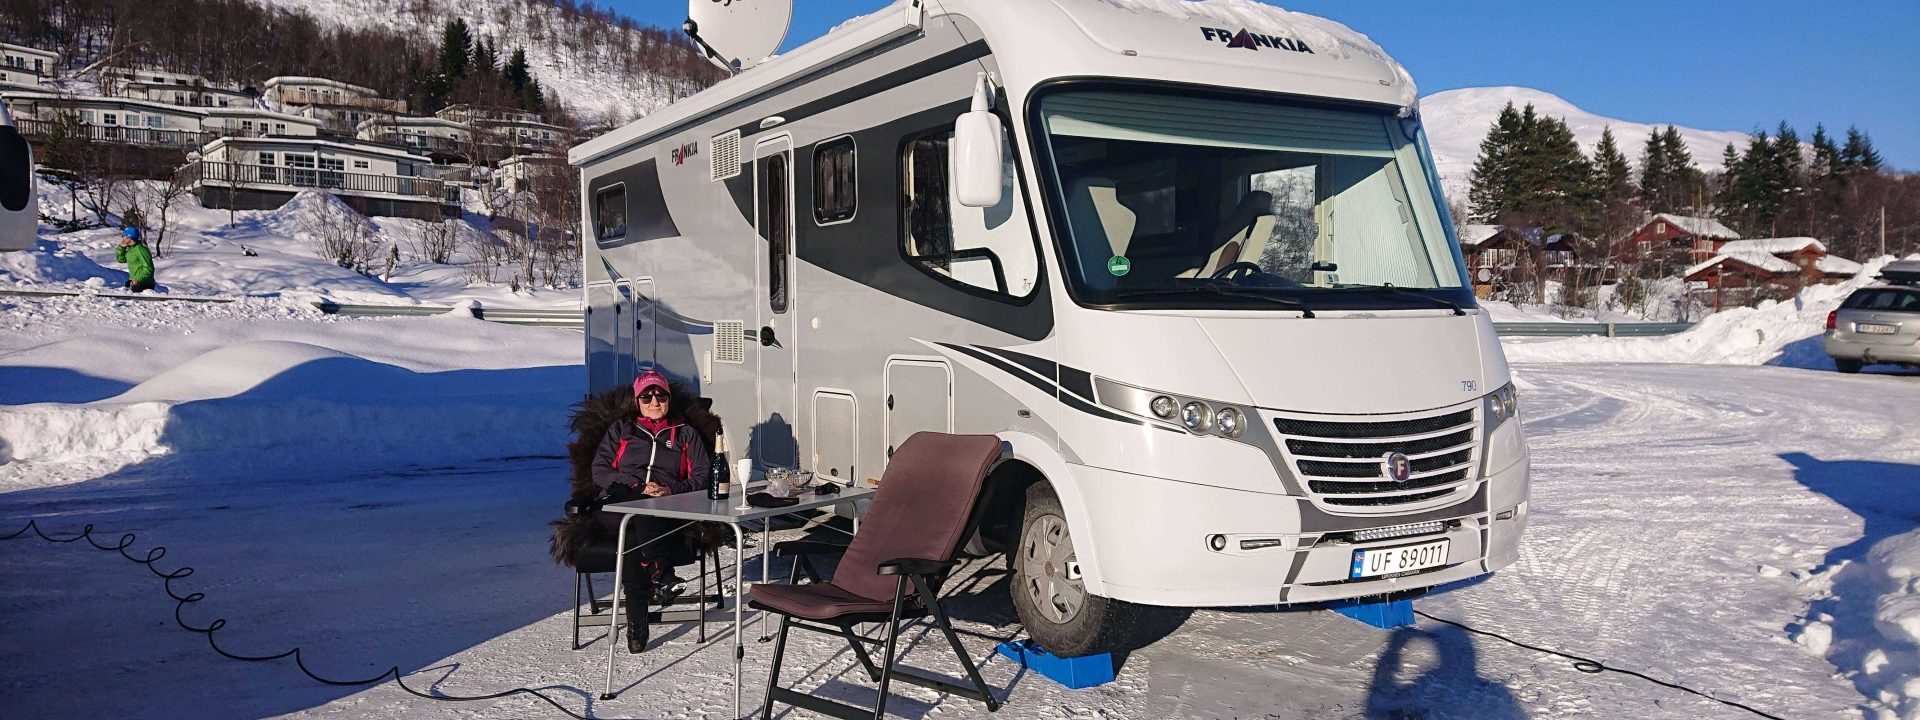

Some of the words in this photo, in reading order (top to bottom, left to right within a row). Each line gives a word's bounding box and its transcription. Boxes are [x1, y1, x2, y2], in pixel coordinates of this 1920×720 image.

[1200, 26, 1315, 54] FRANKIA
[671, 141, 698, 167] FRANKIA
[1461, 380, 1477, 392] 790
[1397, 459, 1405, 476] F
[1371, 552, 1392, 572] UF
[1399, 544, 1442, 568] 89011
